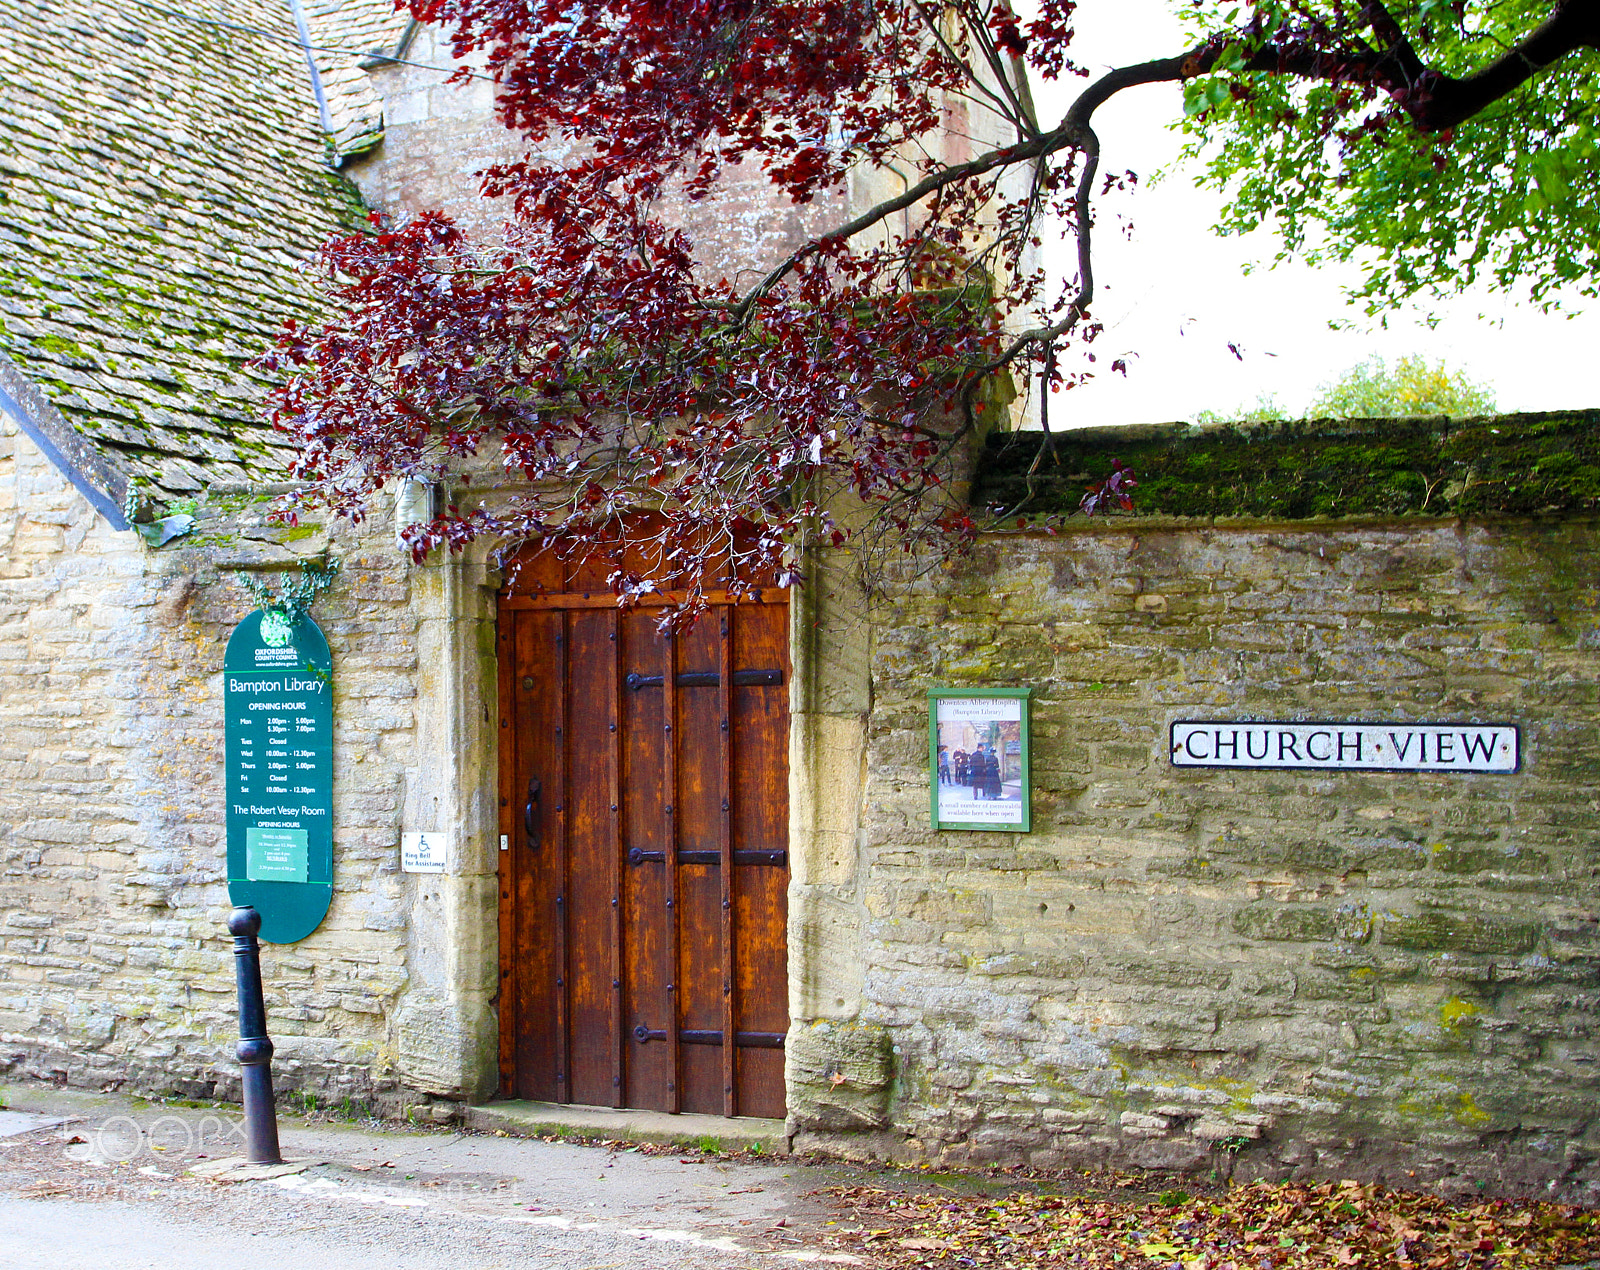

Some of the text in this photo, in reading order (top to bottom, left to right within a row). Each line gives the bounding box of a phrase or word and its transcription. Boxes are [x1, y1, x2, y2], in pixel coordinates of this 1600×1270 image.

[230, 678, 324, 695] Bampton Library
[282, 702, 306, 710] HOURS
[1185, 730, 1500, 763] CHURCH VIEW
[233, 805, 325, 817] The Robert Vesey Room
